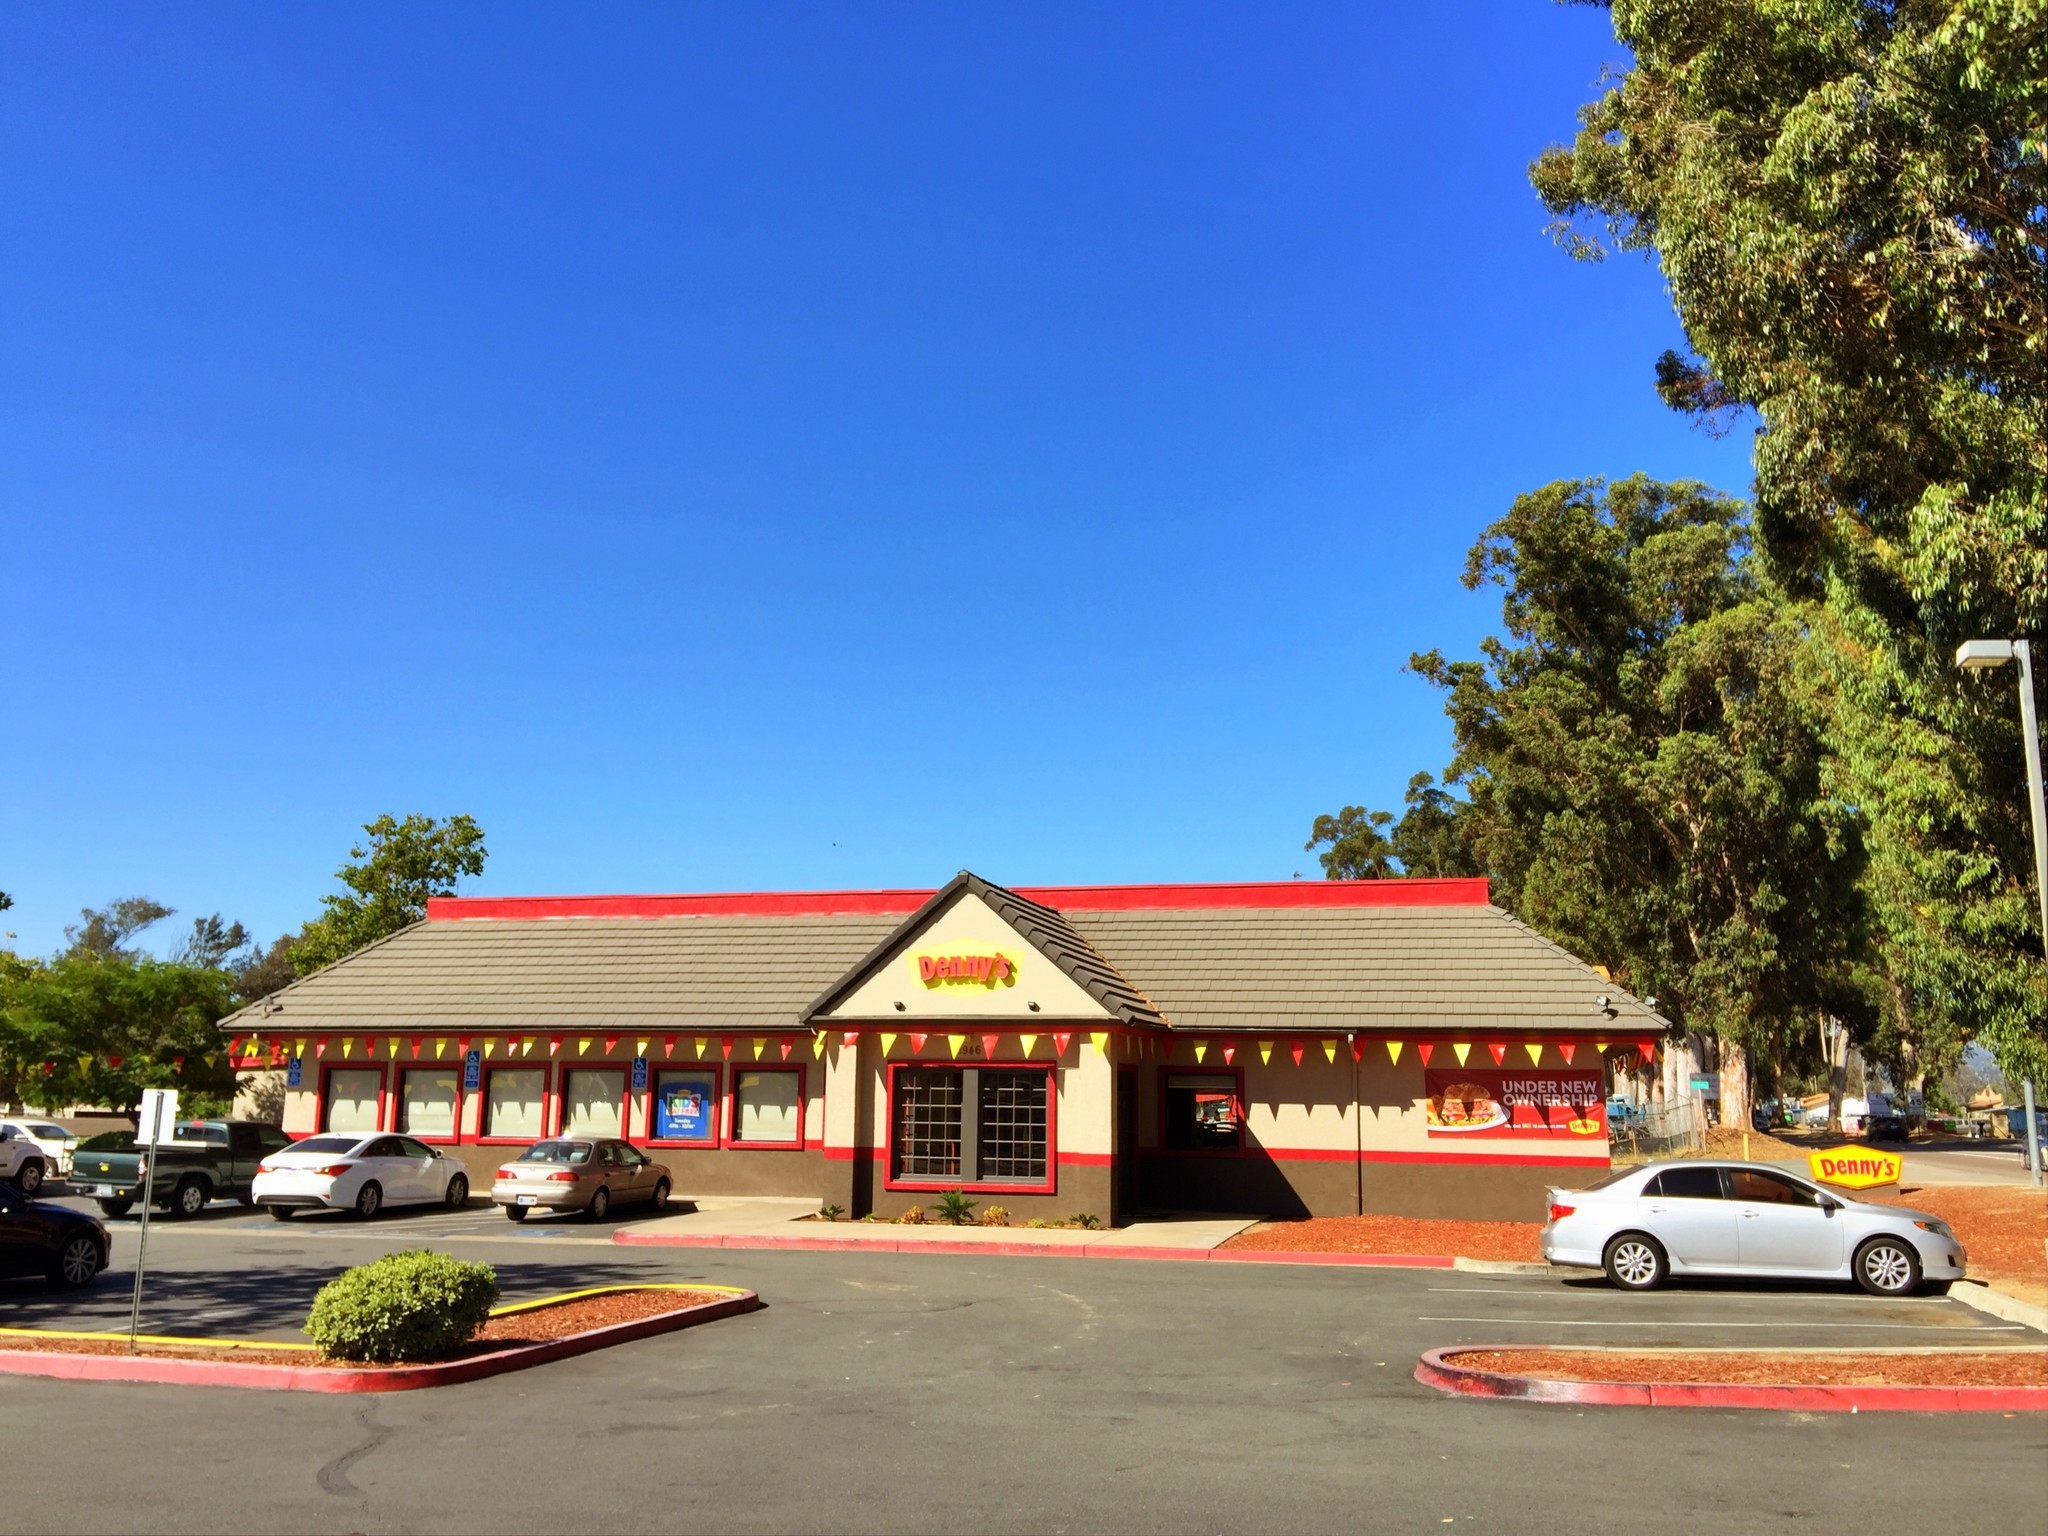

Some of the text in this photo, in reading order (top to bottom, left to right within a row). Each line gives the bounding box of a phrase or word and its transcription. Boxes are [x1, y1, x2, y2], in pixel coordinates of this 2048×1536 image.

[918, 952, 1010, 982] Denny's
[1502, 1080, 1597, 1093] UNDER NEW
[668, 1096, 699, 1108] KIDS
[1502, 1093, 1598, 1107] OWNERSHIP
[1820, 1158, 1895, 1178] Denny's
